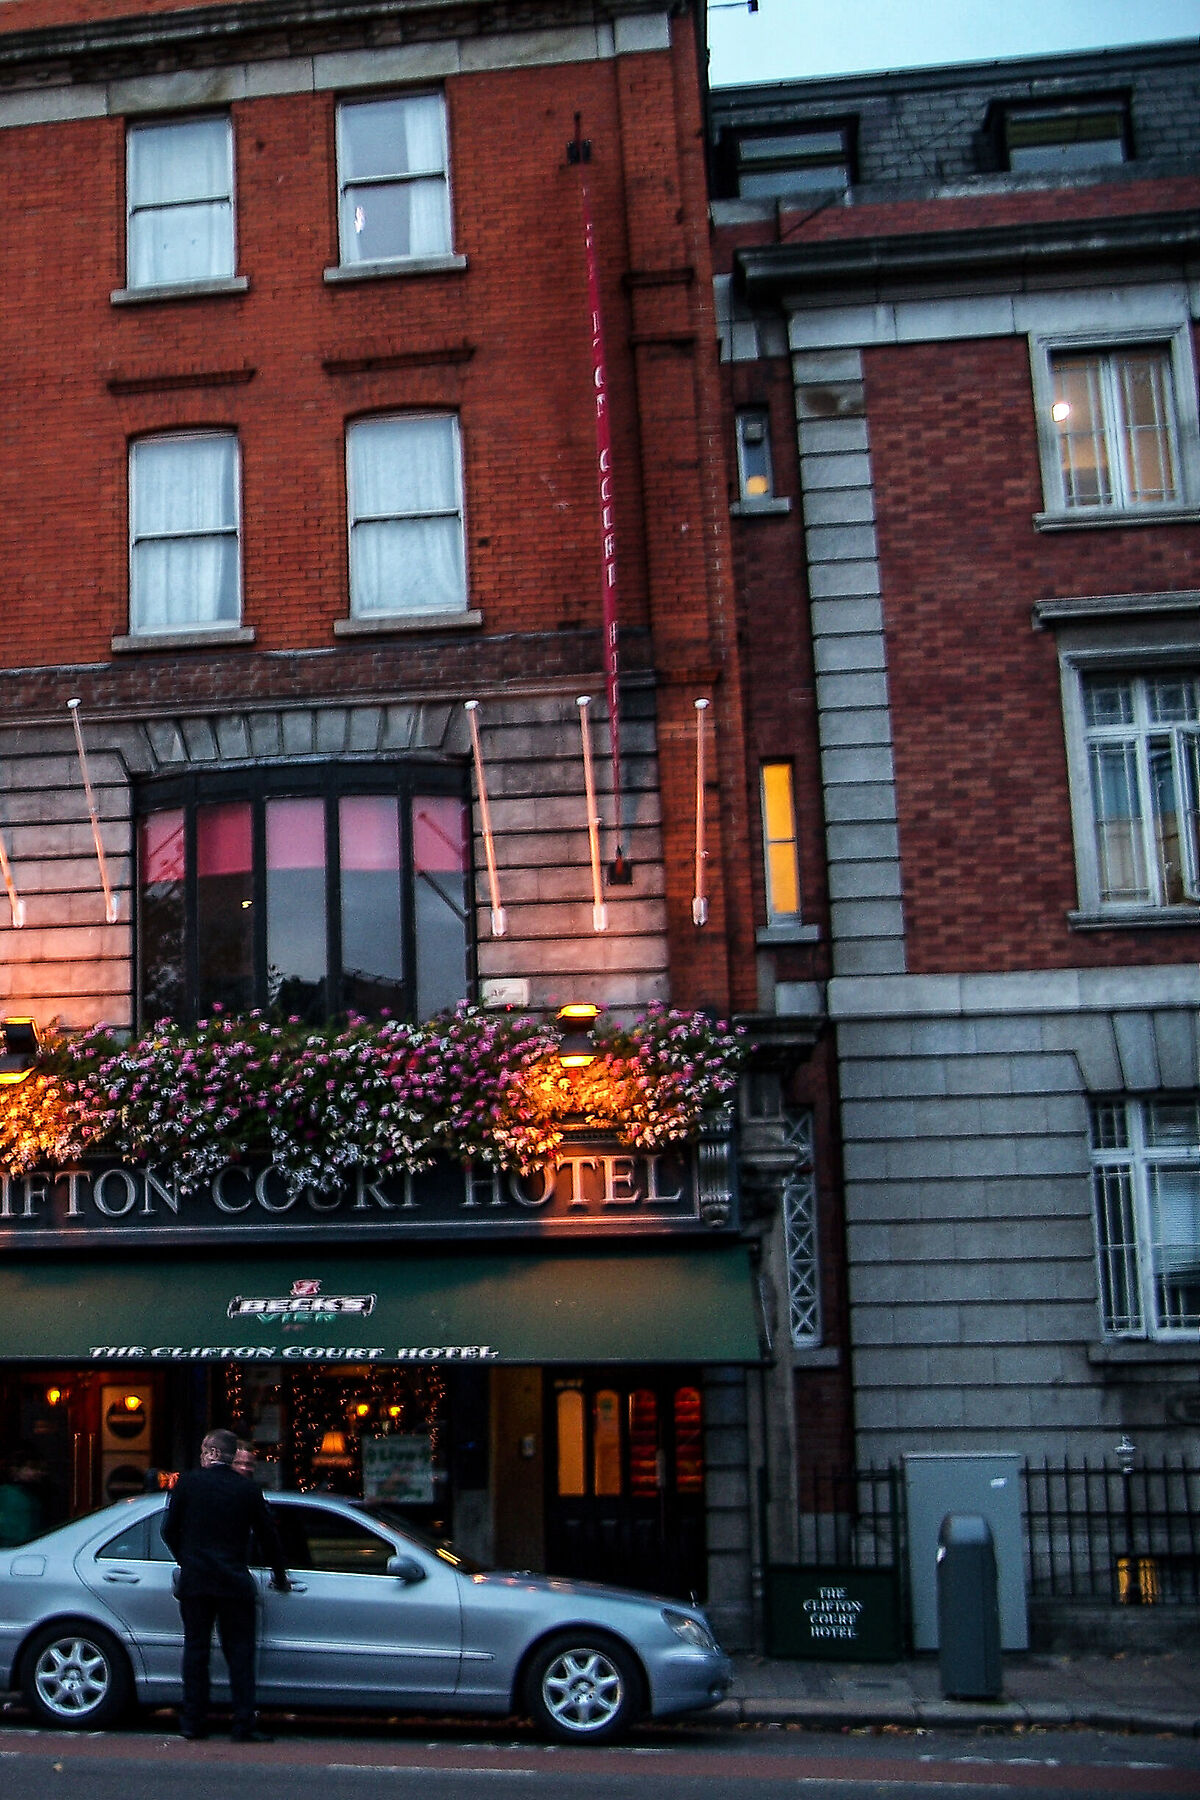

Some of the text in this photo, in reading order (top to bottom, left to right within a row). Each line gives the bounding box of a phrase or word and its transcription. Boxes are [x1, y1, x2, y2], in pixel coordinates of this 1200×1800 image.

[459, 1153, 684, 1208] HOTEL
[89, 1345, 500, 1360] THE CLIFTON COURT HOTEL
[818, 1586, 849, 1600] THE
[802, 1599, 864, 1614] CLIFTON
[809, 1612, 858, 1626] COURT
[810, 1625, 860, 1639] HOTEL
